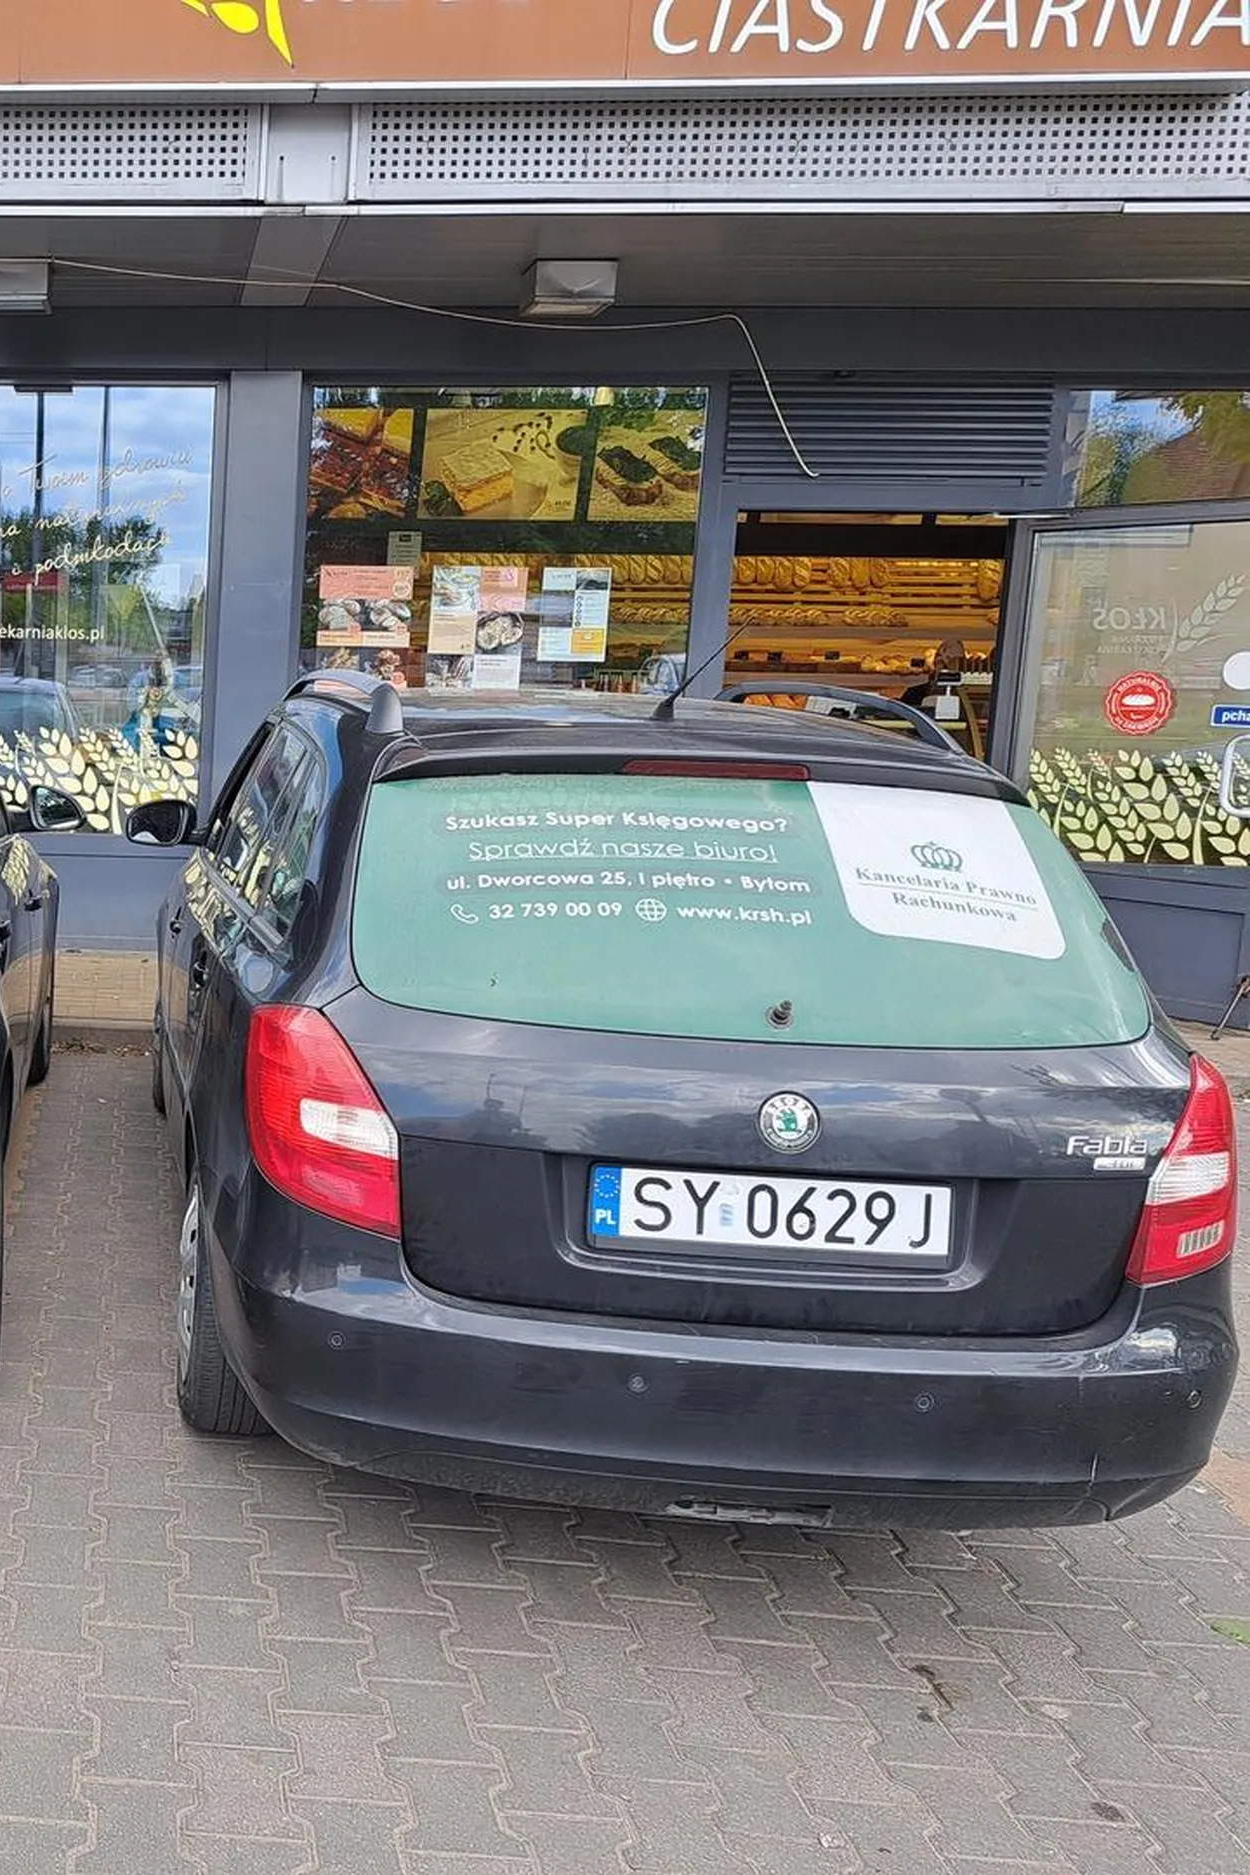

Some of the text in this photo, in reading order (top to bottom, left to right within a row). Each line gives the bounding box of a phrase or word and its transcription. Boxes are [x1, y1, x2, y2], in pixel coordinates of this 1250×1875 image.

[651, 0, 1250, 54] CIASTKARNIA
[445, 812, 788, 833] Szukasz Super Księgowego?
[468, 838, 778, 862] Sprawdź nasze biuro!
[447, 875, 471, 890] ul.
[478, 872, 594, 888] Dworcowa
[600, 871, 632, 887] 25,
[652, 872, 716, 890] piętro
[740, 876, 811, 893] Bytom
[855, 867, 1037, 905] Kancelaria Prawno
[488, 902, 812, 927] 32 739 00 09 www.krsh.pl
[892, 891, 1018, 922] Rachunkowa
[1065, 1133, 1148, 1157] Fabia
[594, 1208, 617, 1225] PL
[632, 1176, 934, 1249] SY 0629J
